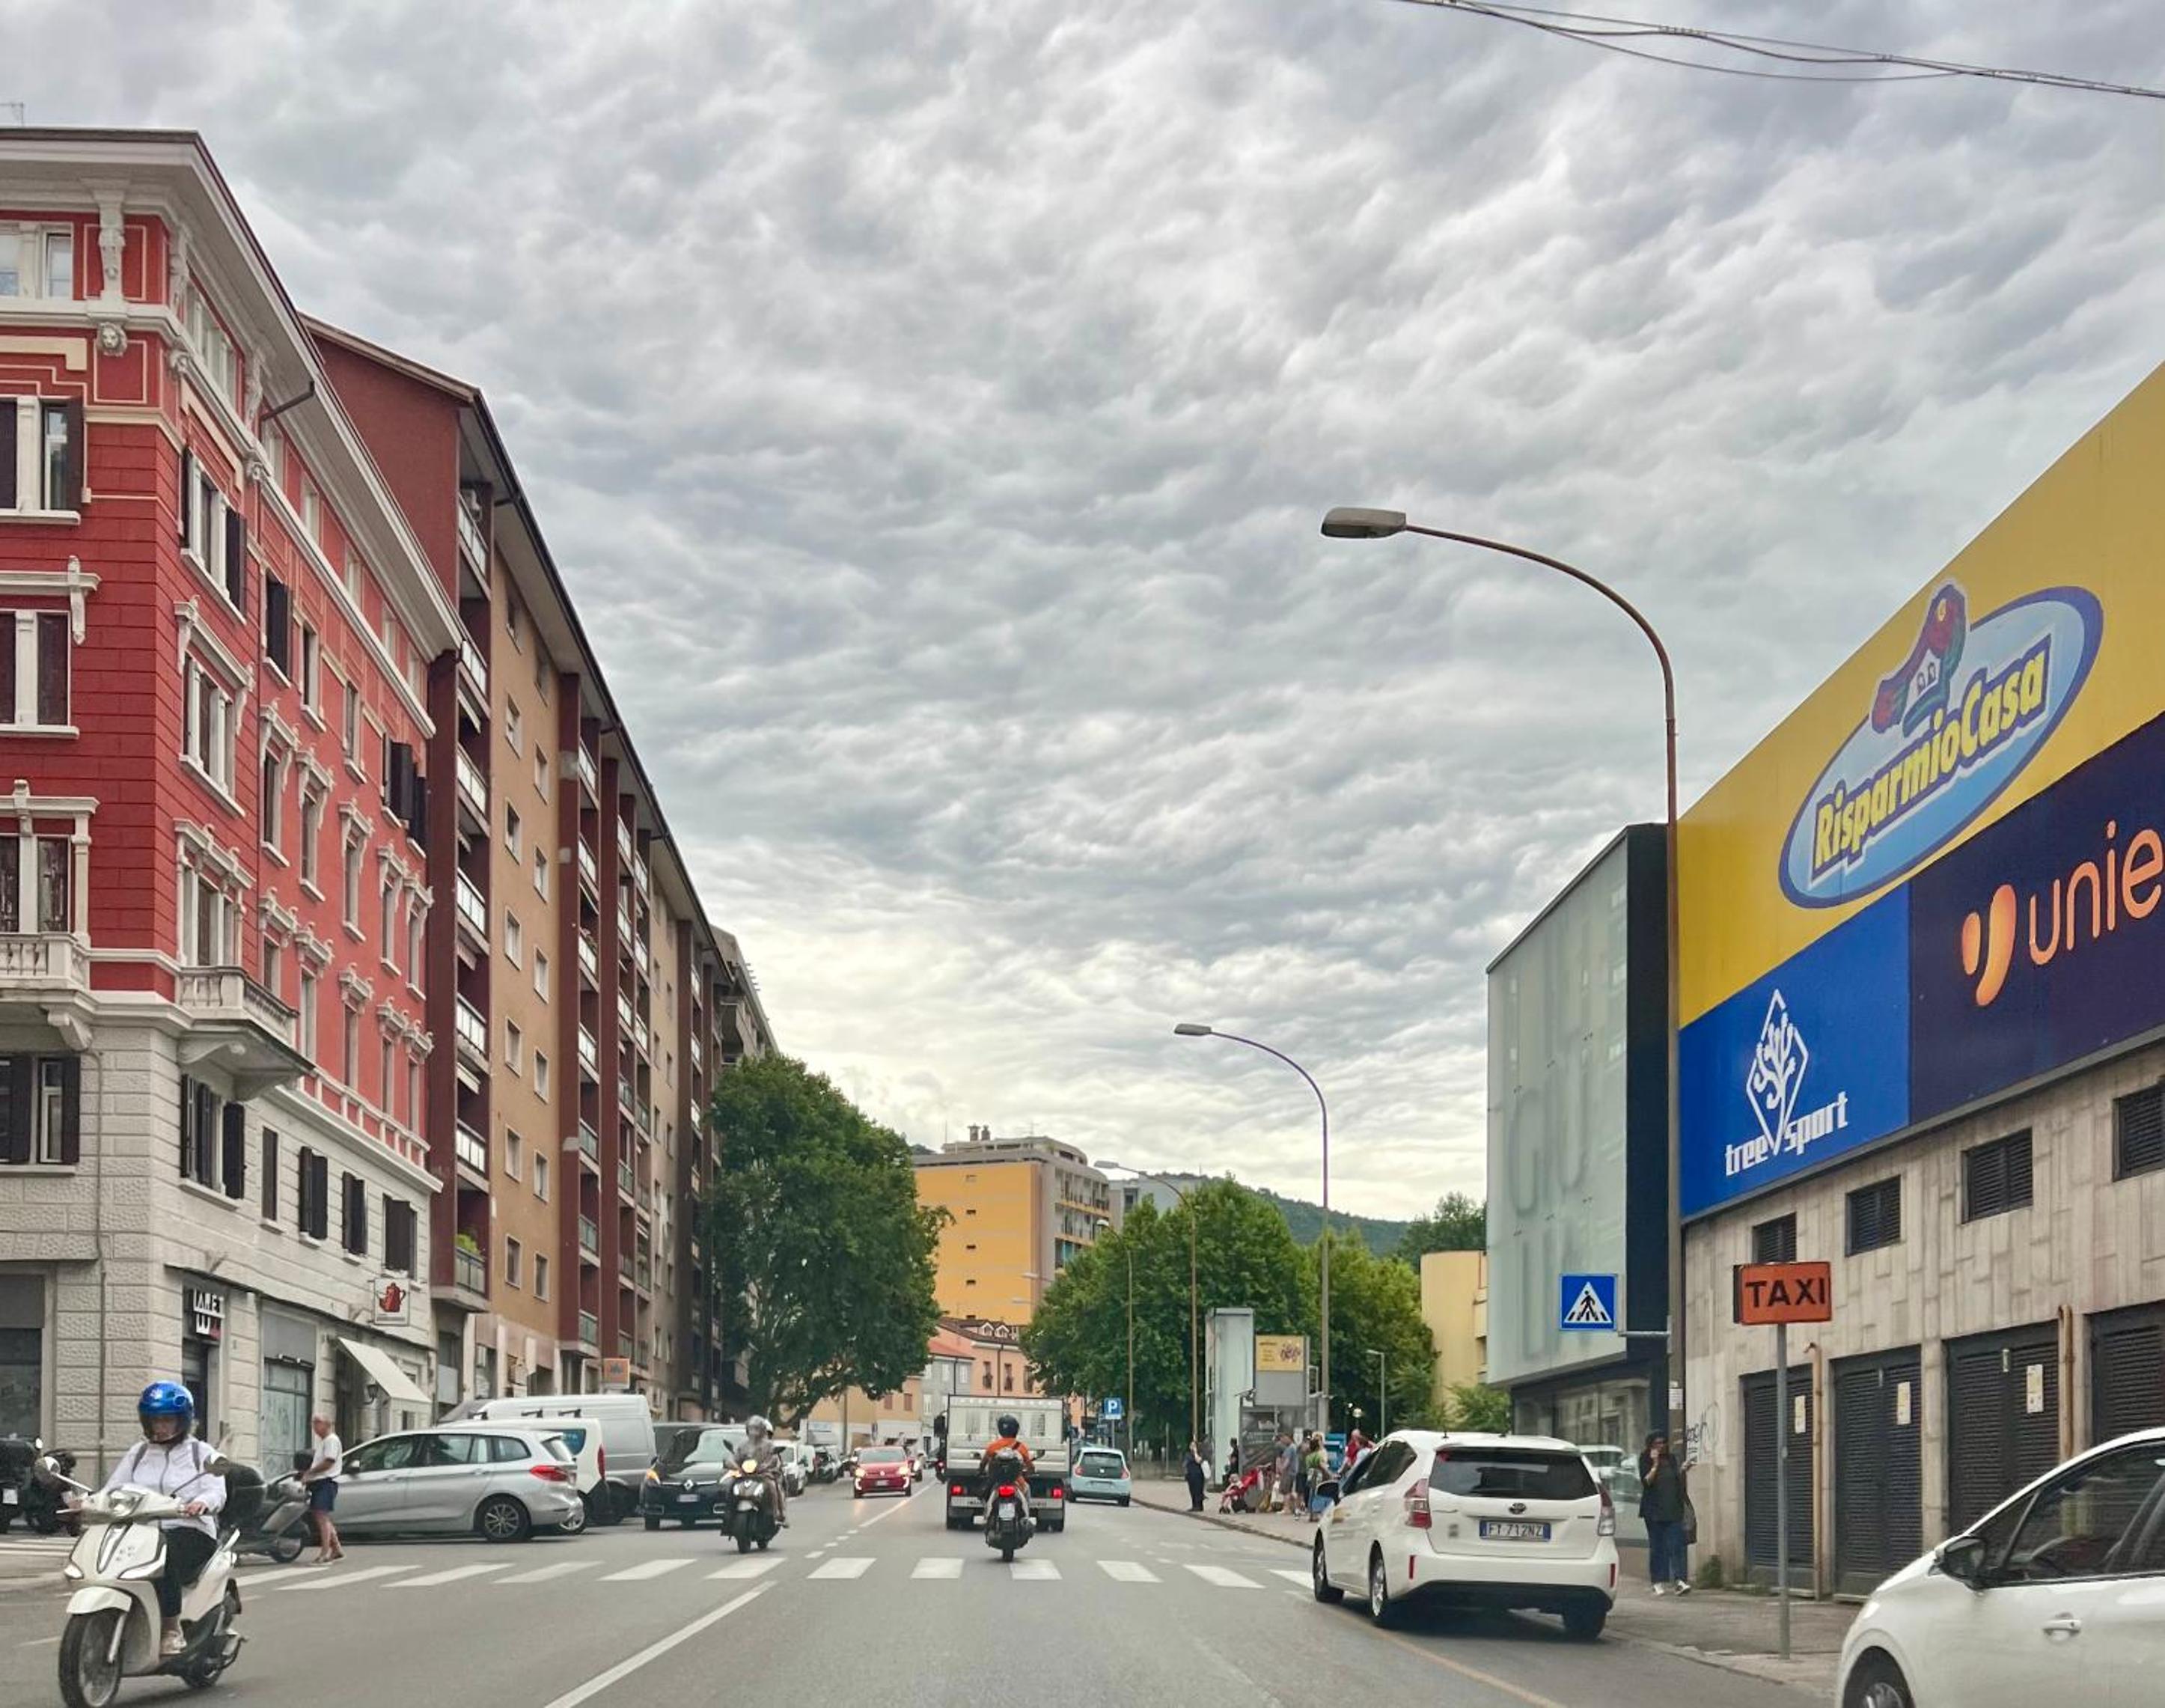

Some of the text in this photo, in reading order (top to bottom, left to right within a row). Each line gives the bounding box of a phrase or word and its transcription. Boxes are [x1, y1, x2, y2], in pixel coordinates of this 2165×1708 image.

[1813, 648, 2047, 870] RisparmioCasa
[1725, 1091, 1848, 1176] tree sport
[1745, 1277, 1826, 1308] TAXI
[1108, 1400, 1118, 1413] P
